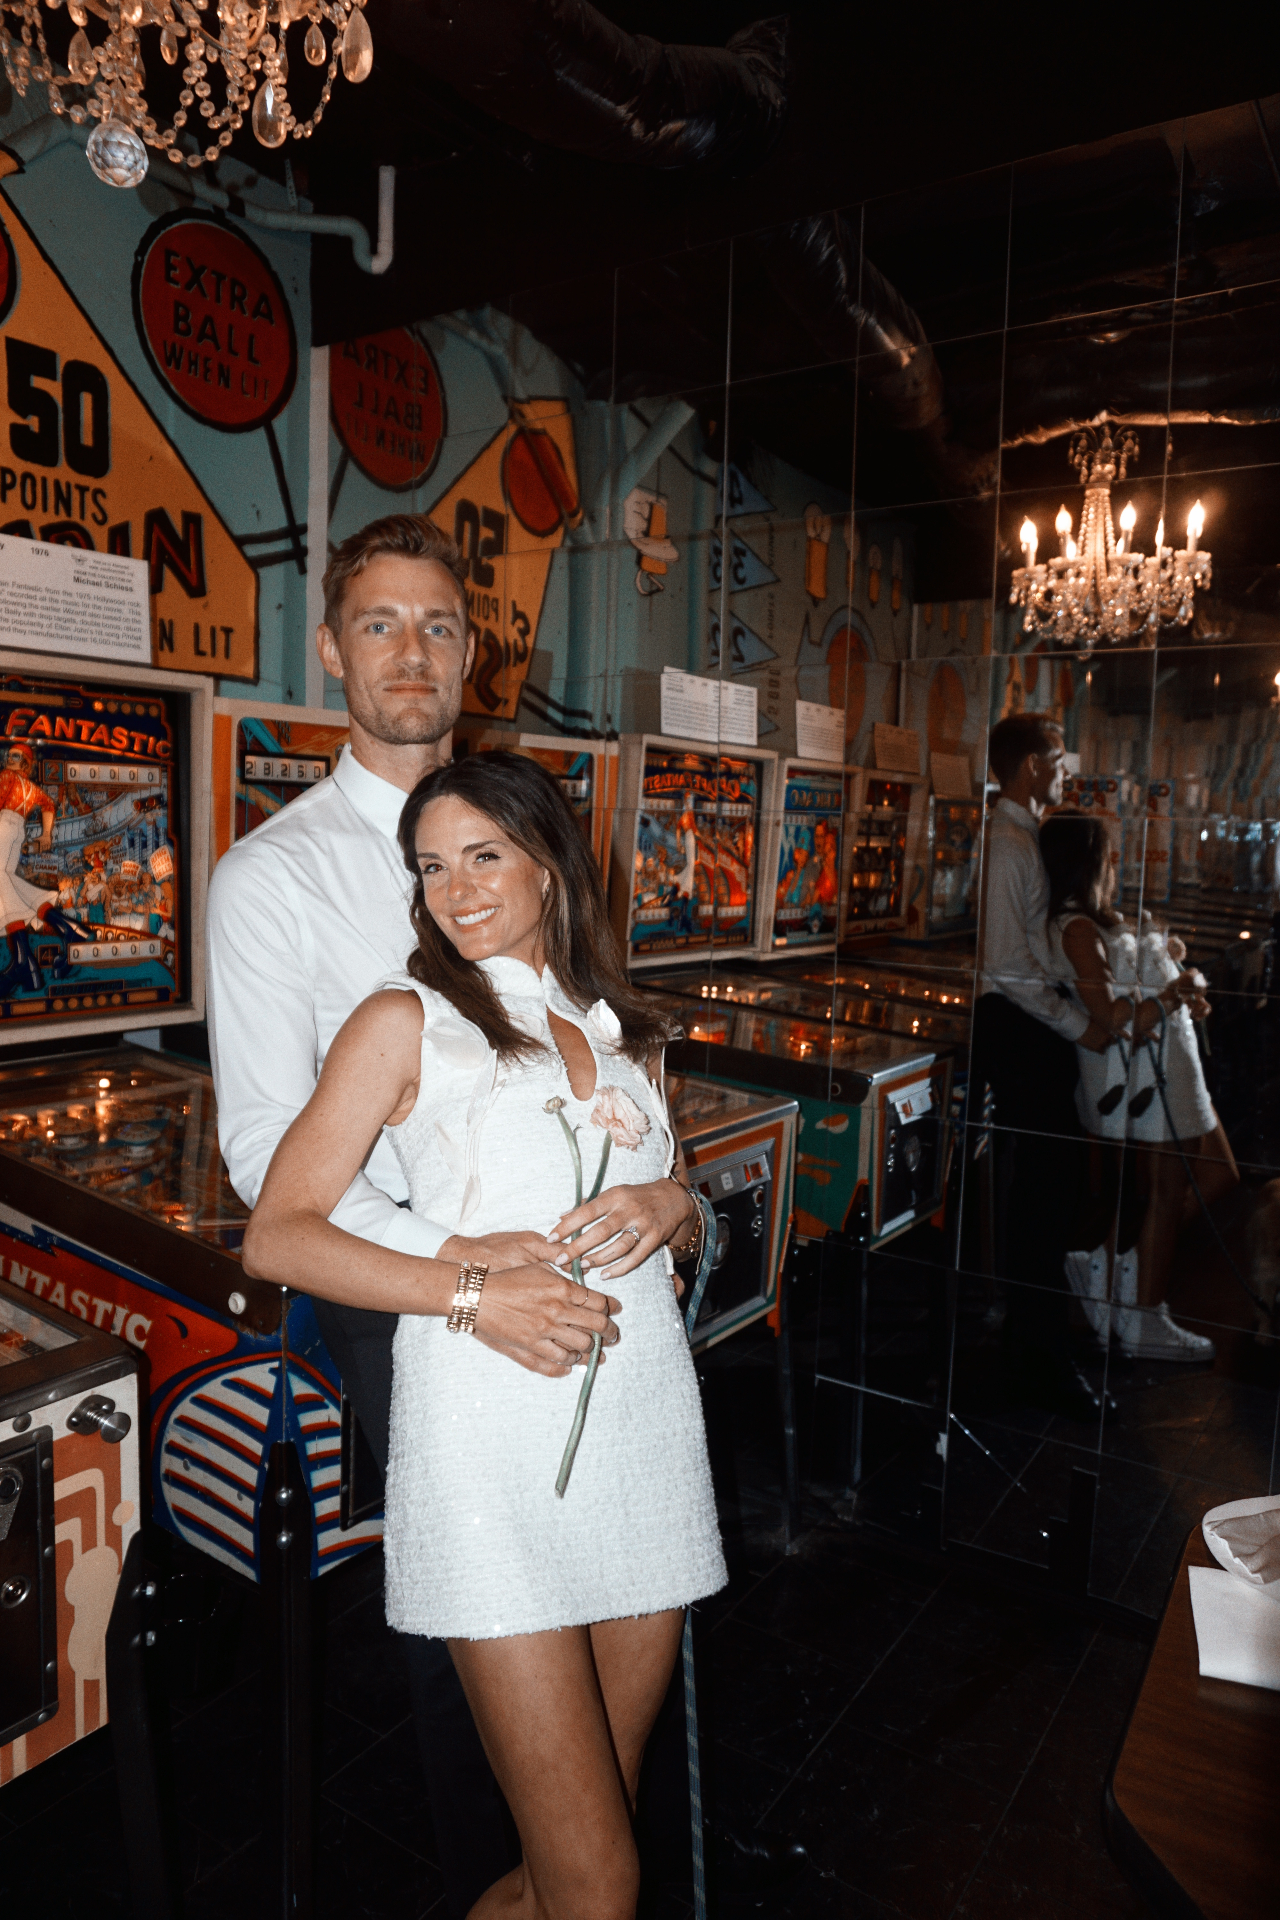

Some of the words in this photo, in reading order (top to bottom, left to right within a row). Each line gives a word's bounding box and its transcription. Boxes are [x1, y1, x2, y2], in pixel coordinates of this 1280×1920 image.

[164, 249, 276, 326] EXTRA
[173, 299, 262, 366] BALL
[163, 339, 232, 391] WHEN
[241, 371, 271, 402] LIT
[5, 336, 111, 479] 50
[0, 466, 108, 526] POINTS
[31, 547, 50, 557] 1976
[7, 590, 37, 602] recorded
[48, 597, 60, 605] the
[12, 581, 42, 593] Fantastic
[45, 586, 60, 595] from
[62, 590, 73, 598] the
[93, 594, 126, 606] Hollywood
[73, 576, 102, 588] Michael
[4, 607, 21, 617] Bally
[23, 610, 36, 618] with
[54, 623, 71, 632] Elton
[12, 627, 27, 636] they
[193, 621, 234, 659] LIT
[5, 707, 173, 758] FANTASTIC
